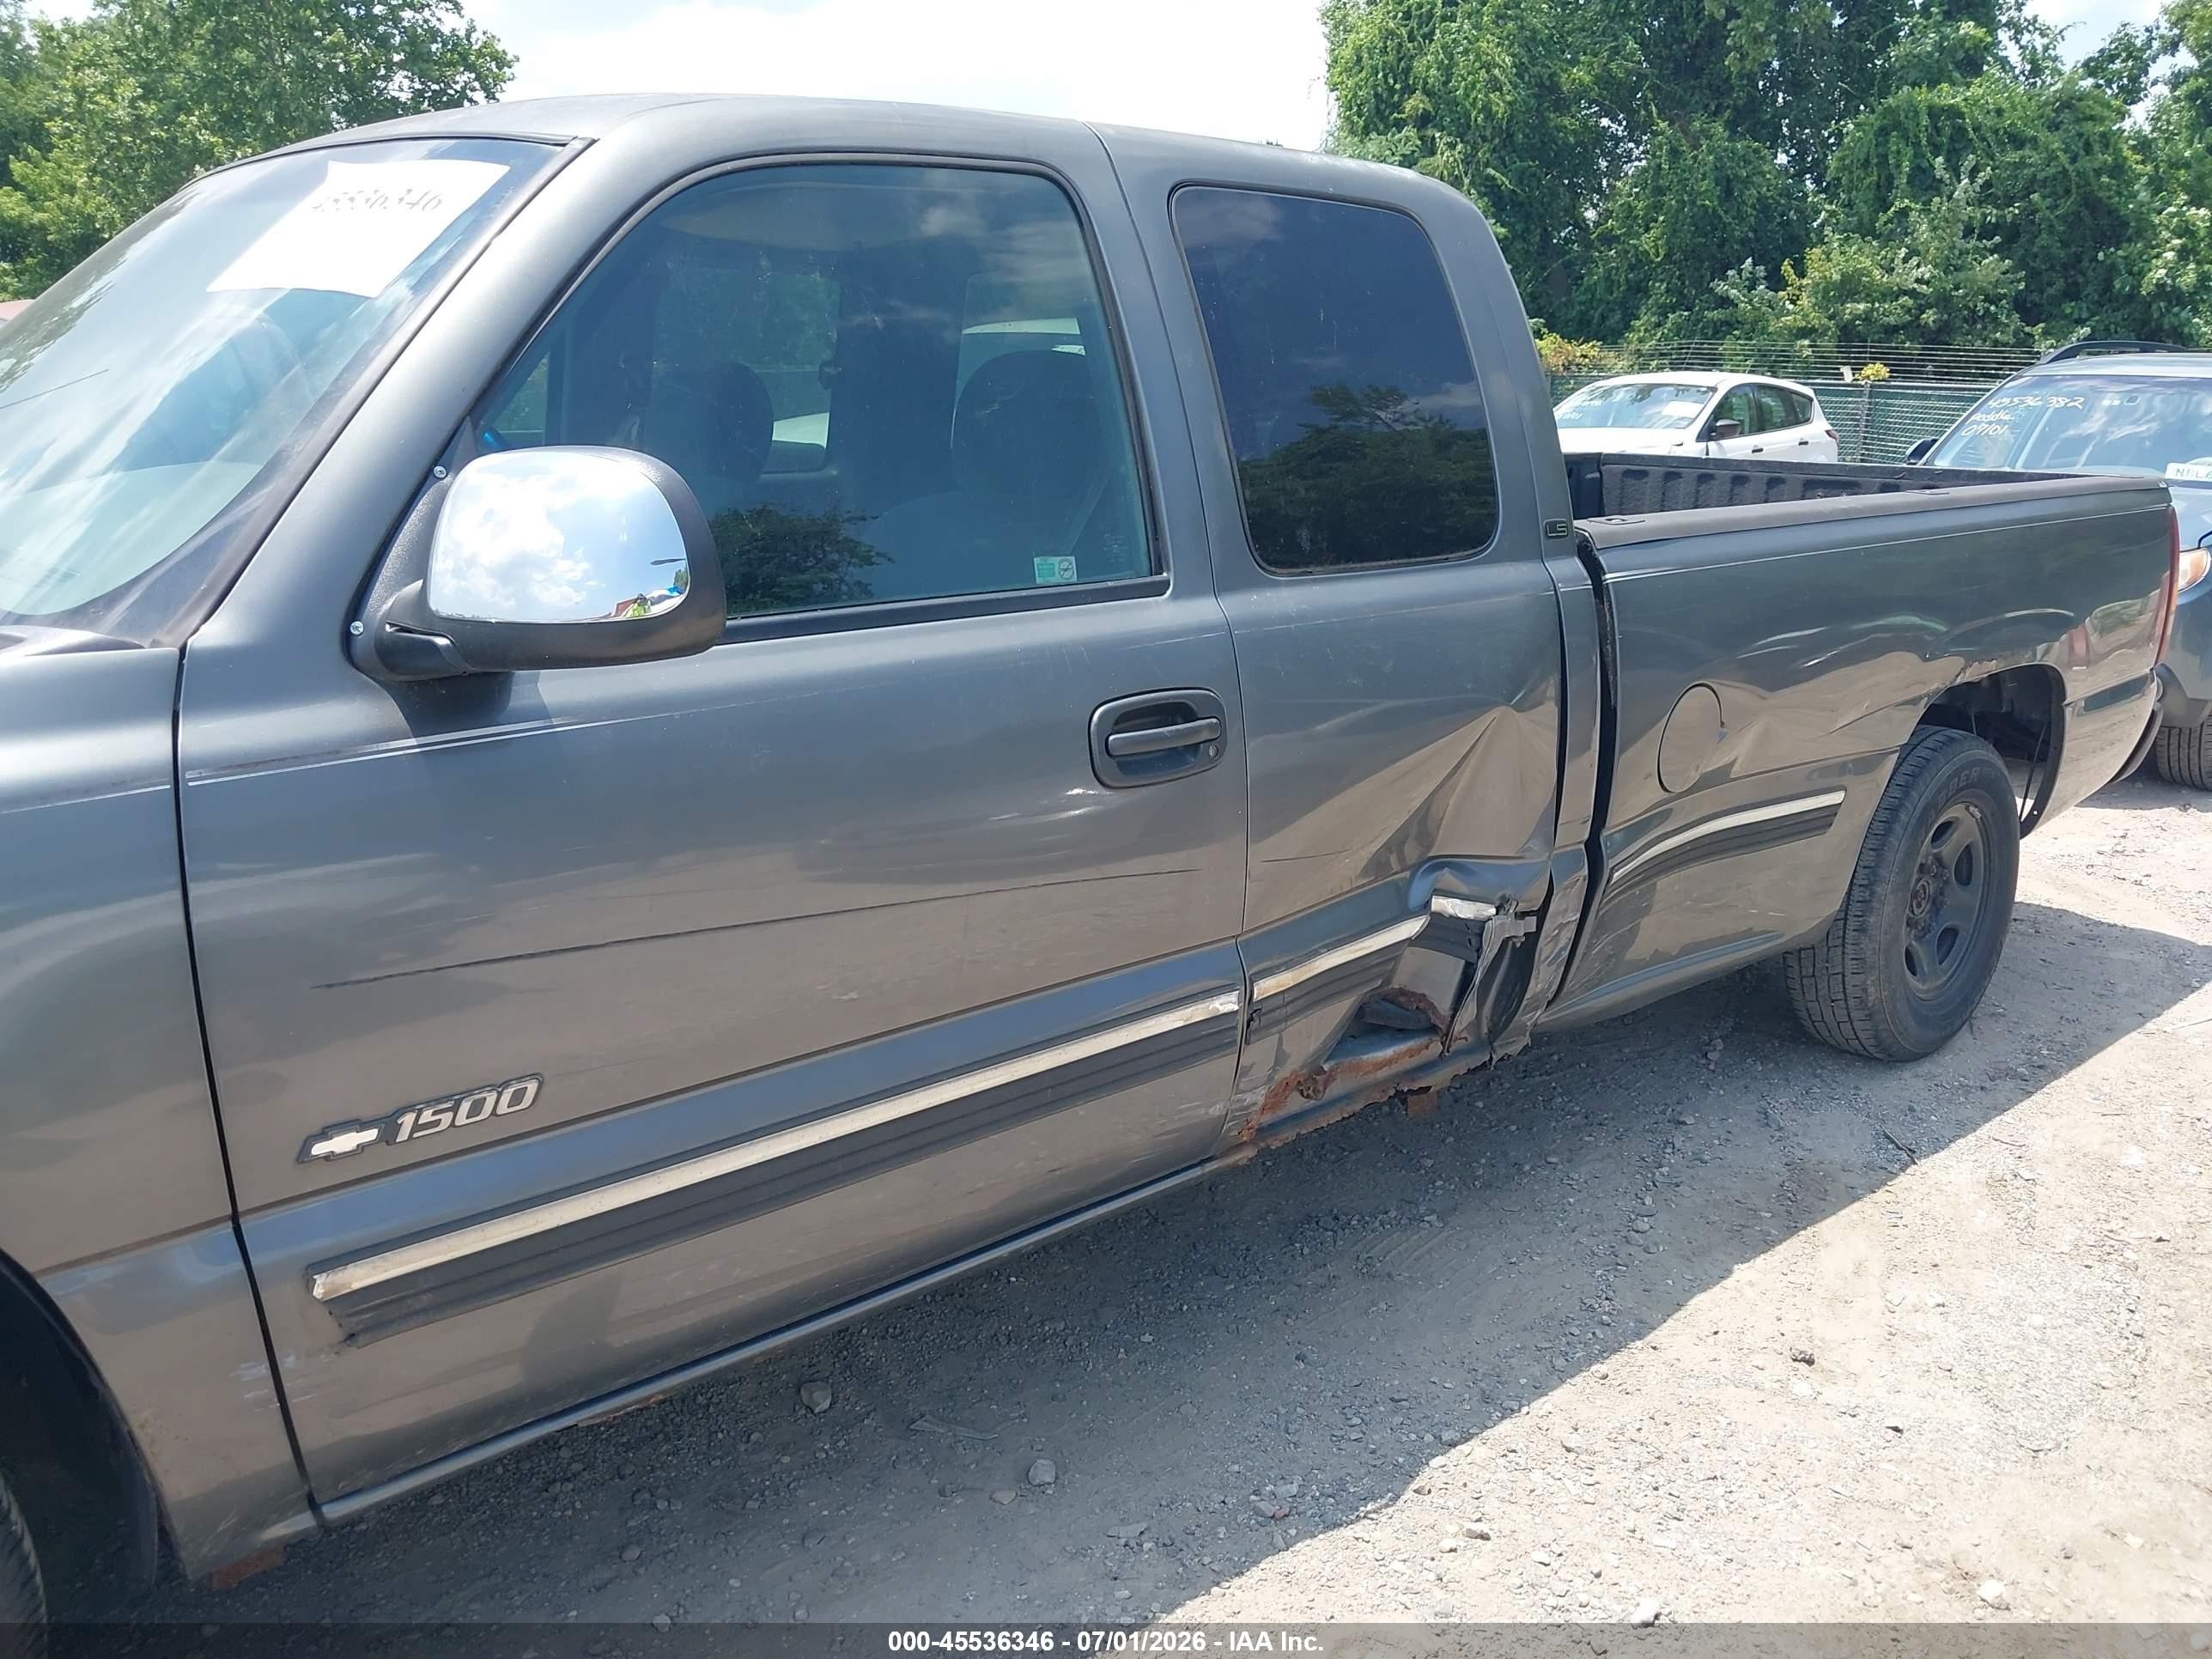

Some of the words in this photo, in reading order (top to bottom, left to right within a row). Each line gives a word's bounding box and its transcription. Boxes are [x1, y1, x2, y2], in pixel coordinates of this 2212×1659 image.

[1961, 422, 2009, 435] 07/01
[1547, 523, 1568, 537] LS
[393, 1075, 542, 1144] 1500
